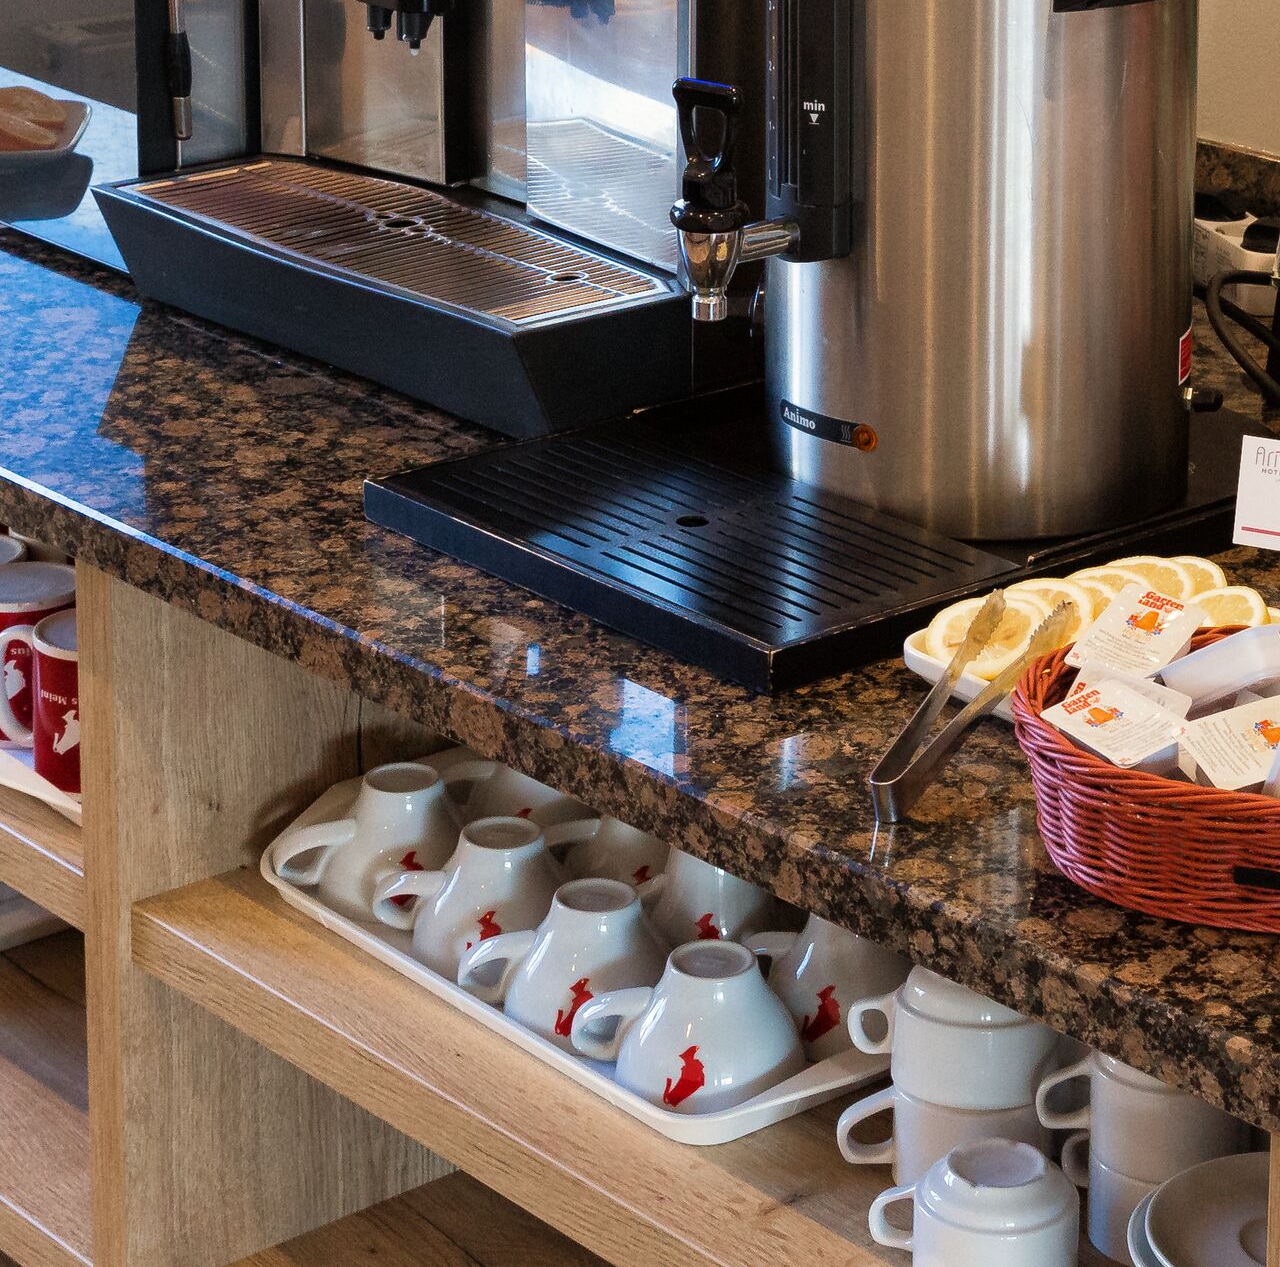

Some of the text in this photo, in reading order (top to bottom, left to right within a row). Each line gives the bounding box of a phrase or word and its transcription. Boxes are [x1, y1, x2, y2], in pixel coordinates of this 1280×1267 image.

[804, 100, 825, 111] min
[784, 407, 815, 429] Animo
[1142, 591, 1184, 611] Garten
[40, 690, 67, 705] Meinl
[1061, 689, 1101, 708] Garten
[1064, 701, 1091, 715] land
